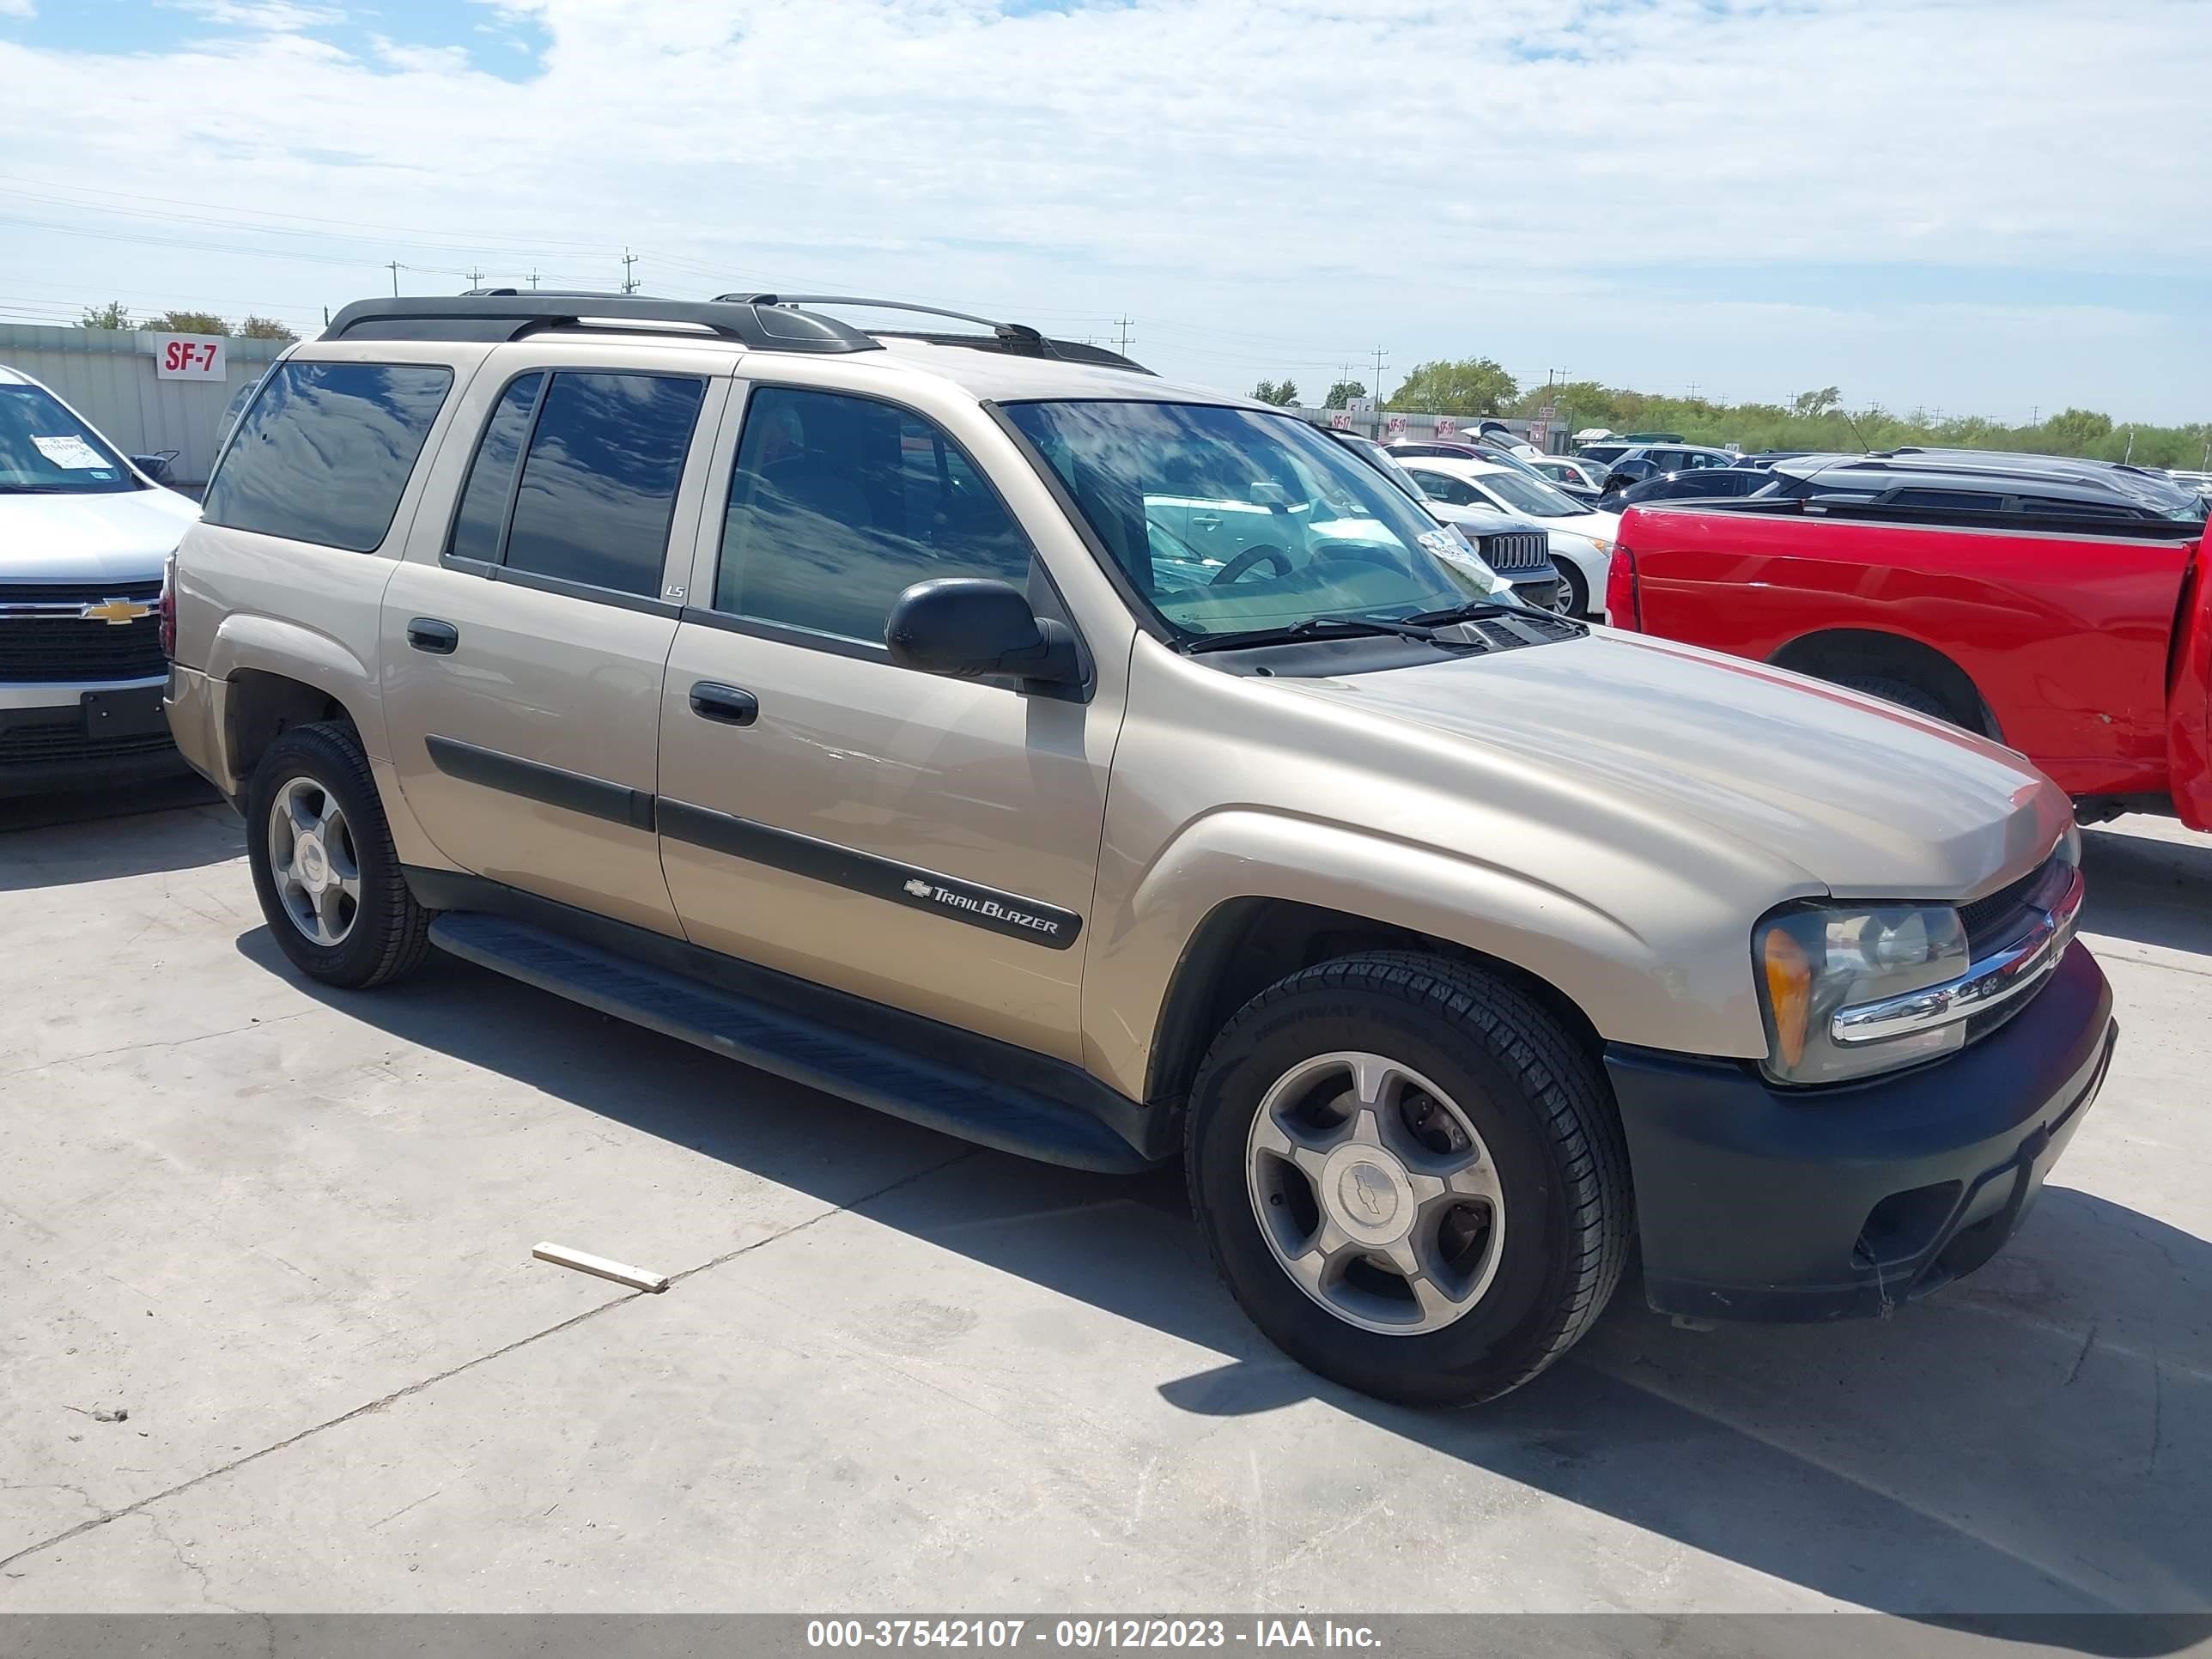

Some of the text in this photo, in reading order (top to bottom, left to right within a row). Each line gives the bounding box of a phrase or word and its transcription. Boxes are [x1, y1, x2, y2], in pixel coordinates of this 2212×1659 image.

[166, 342, 216, 371] SF-7
[1332, 416, 1351, 430] SF-17
[1389, 418, 1407, 433] SF-18
[1437, 421, 1455, 434] SF-19
[666, 585, 685, 598] LS
[934, 886, 1059, 934] TRAILBLAZER
